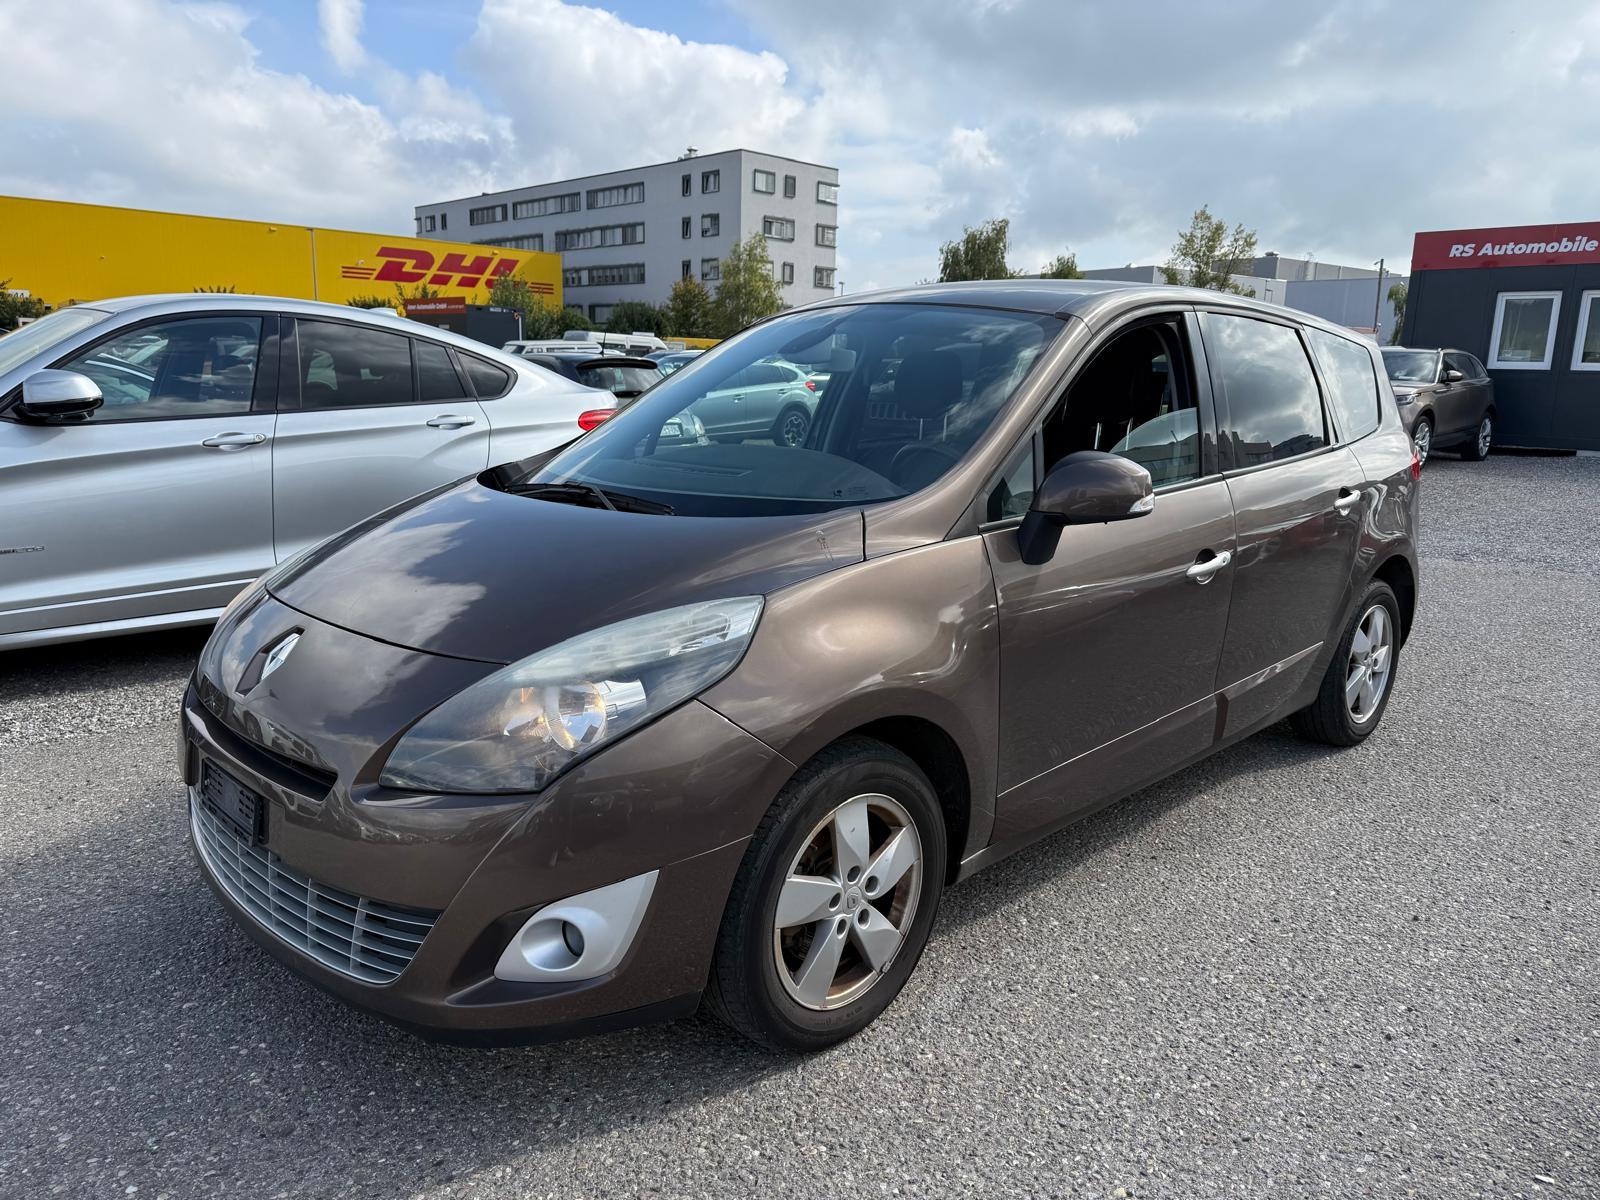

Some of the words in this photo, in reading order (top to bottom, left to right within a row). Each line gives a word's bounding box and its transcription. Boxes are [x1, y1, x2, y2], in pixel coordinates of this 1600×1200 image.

[1449, 243, 1476, 258] RS
[1477, 235, 1599, 257] Automobile
[374, 246, 528, 291] DHL
